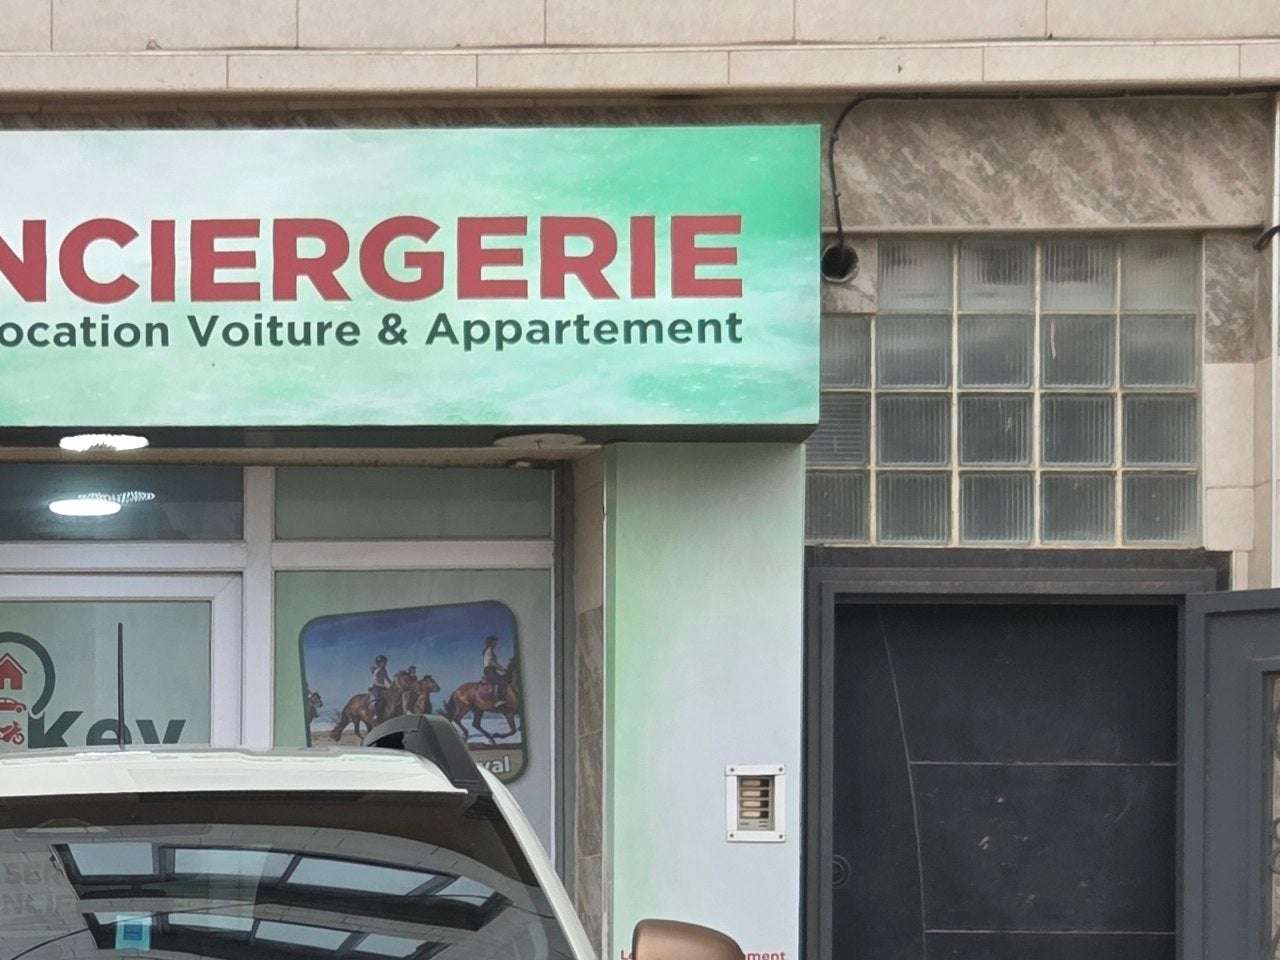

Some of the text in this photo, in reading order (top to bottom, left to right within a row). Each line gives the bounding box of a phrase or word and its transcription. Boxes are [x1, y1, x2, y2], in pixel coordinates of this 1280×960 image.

[187, 313, 360, 347] Voiture
[377, 313, 408, 346] &
[425, 311, 743, 350] Appartement
